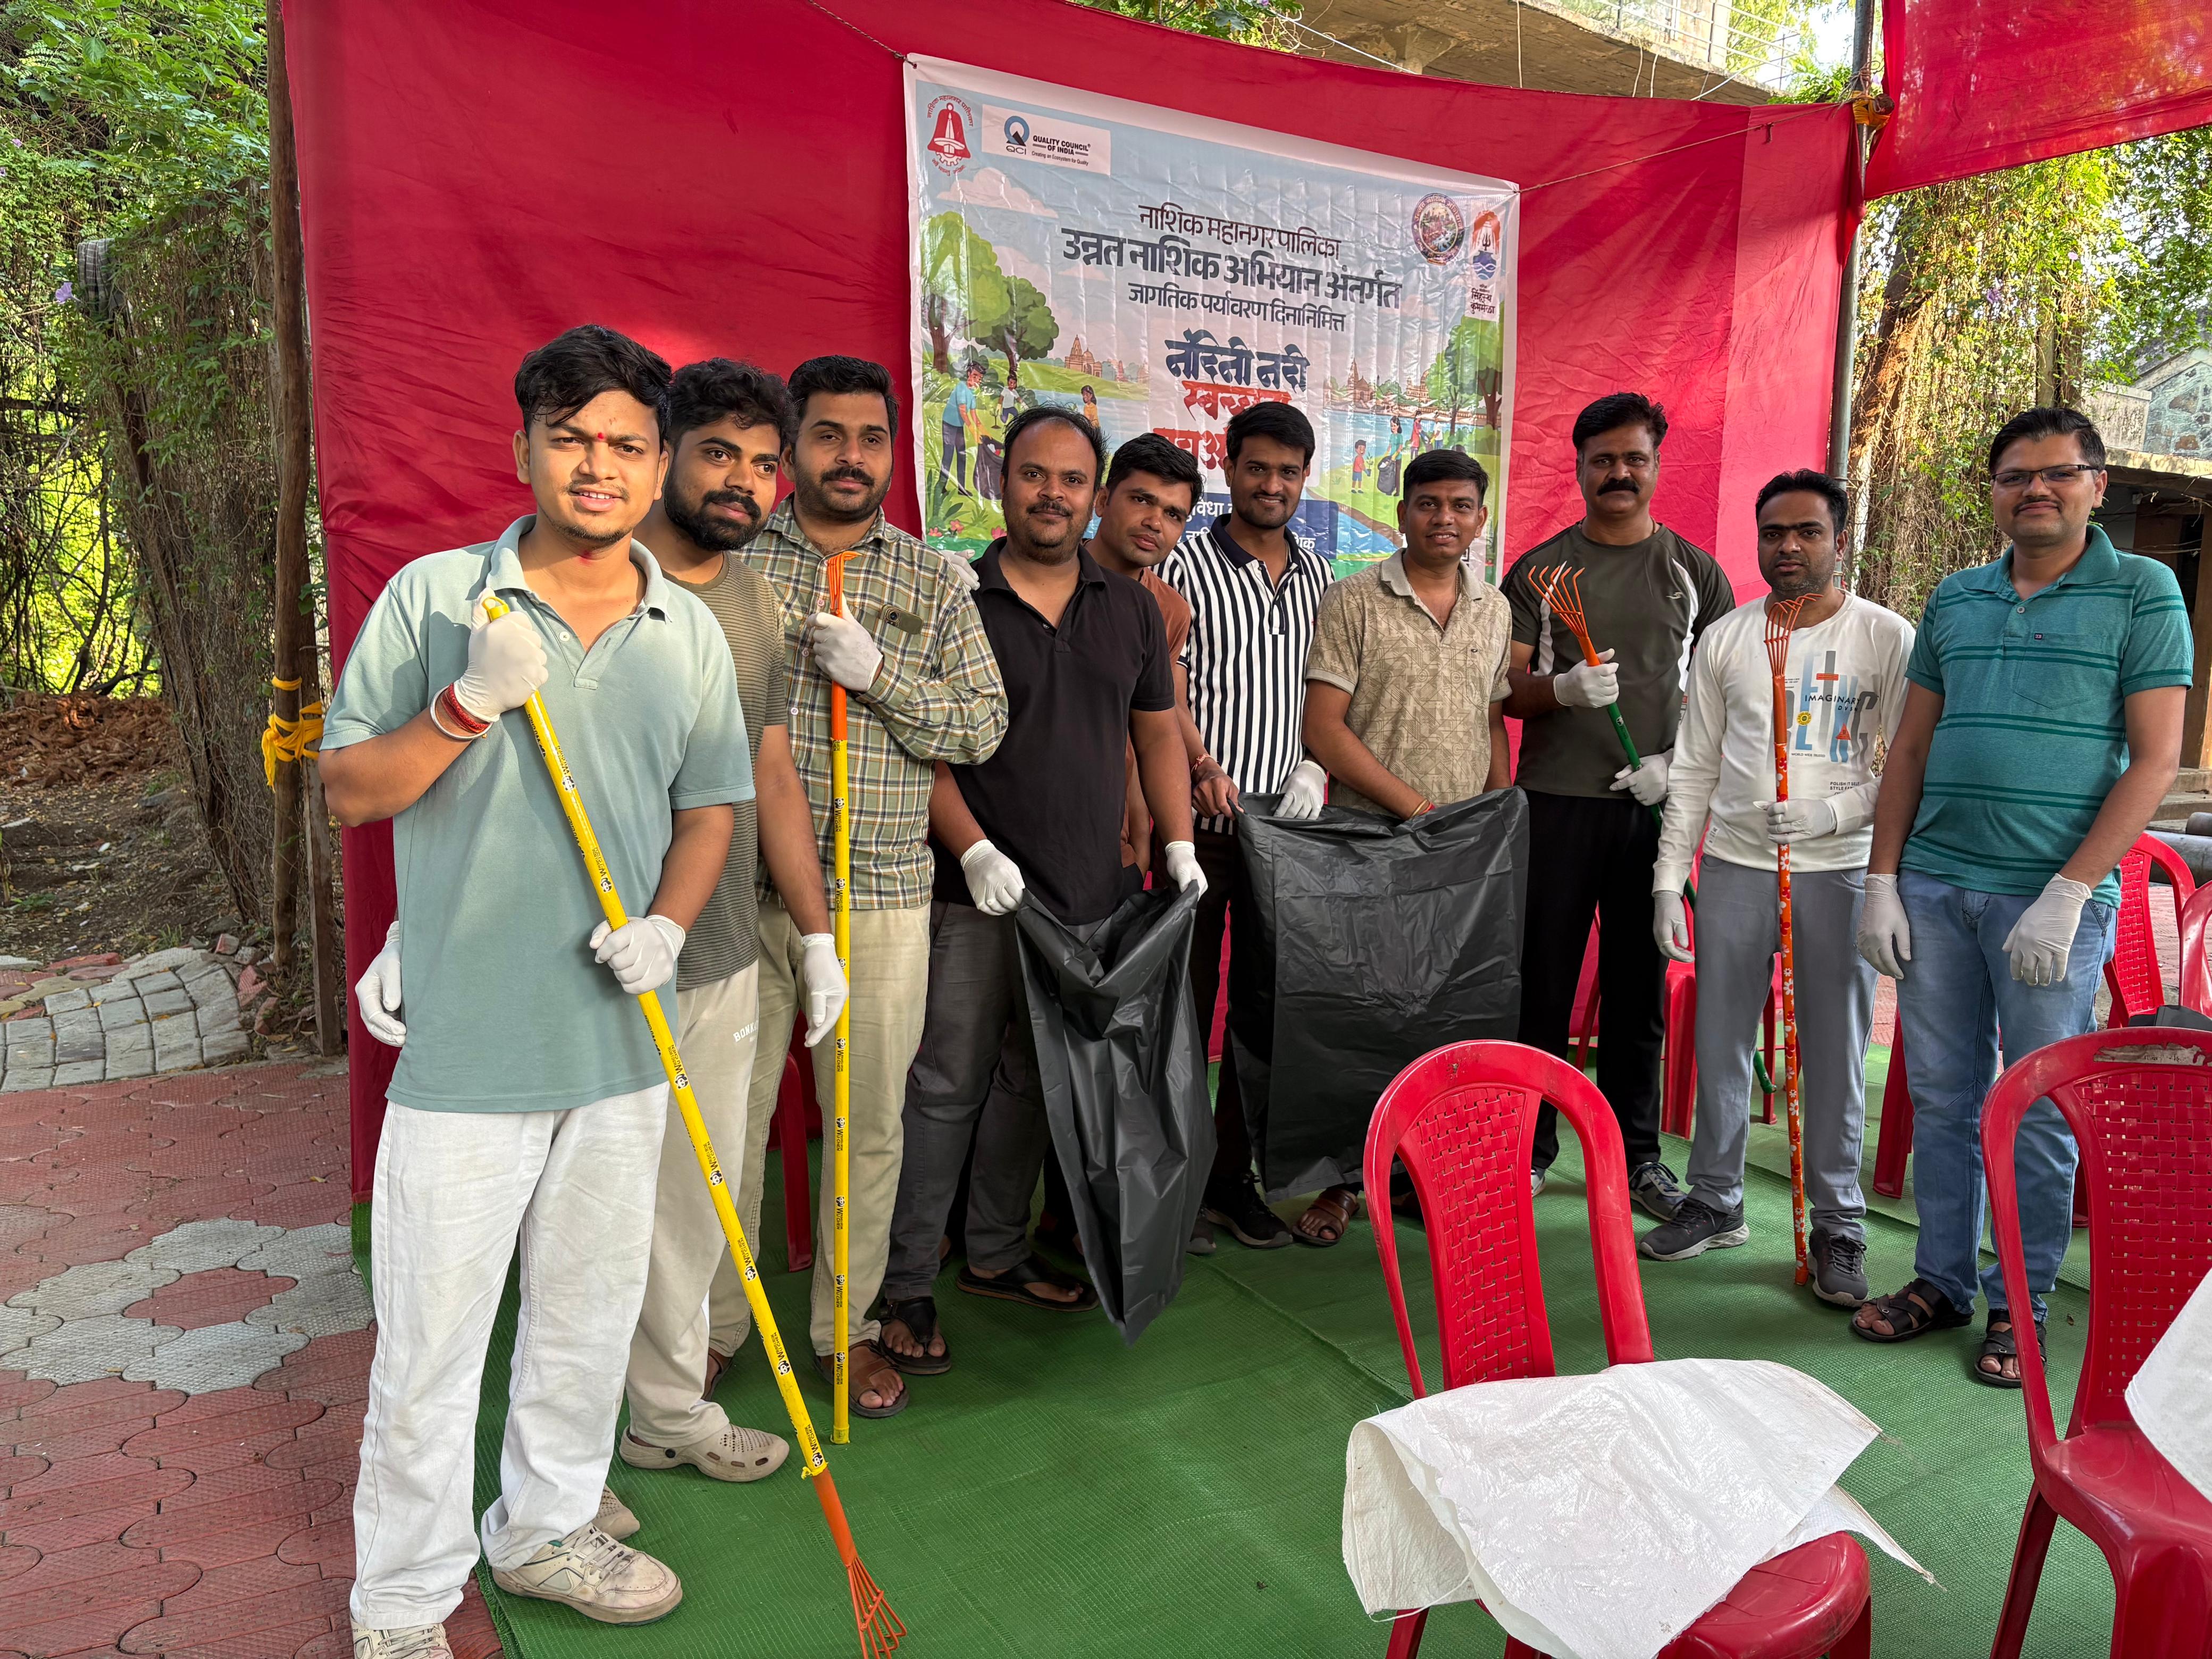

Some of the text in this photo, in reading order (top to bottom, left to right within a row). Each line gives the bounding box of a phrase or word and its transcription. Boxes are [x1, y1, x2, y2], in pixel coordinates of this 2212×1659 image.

[1033, 136, 1059, 145] QUALITY
[1006, 145, 1026, 155] QCI
[1058, 146, 1074, 155] INDIA
[1052, 154, 1071, 162] Ecosystem
[1138, 202, 1342, 260] नाशिक महानगर पालिका
[1061, 228, 1403, 309] उन्नत नाशिक अभियान अंतर्गत
[1128, 281, 1346, 331] जागतिक पर्यावरण दिनानिमित्त
[1164, 328, 1310, 393] नंदिनी नदी
[1805, 694, 1861, 705] IMAGINARY
